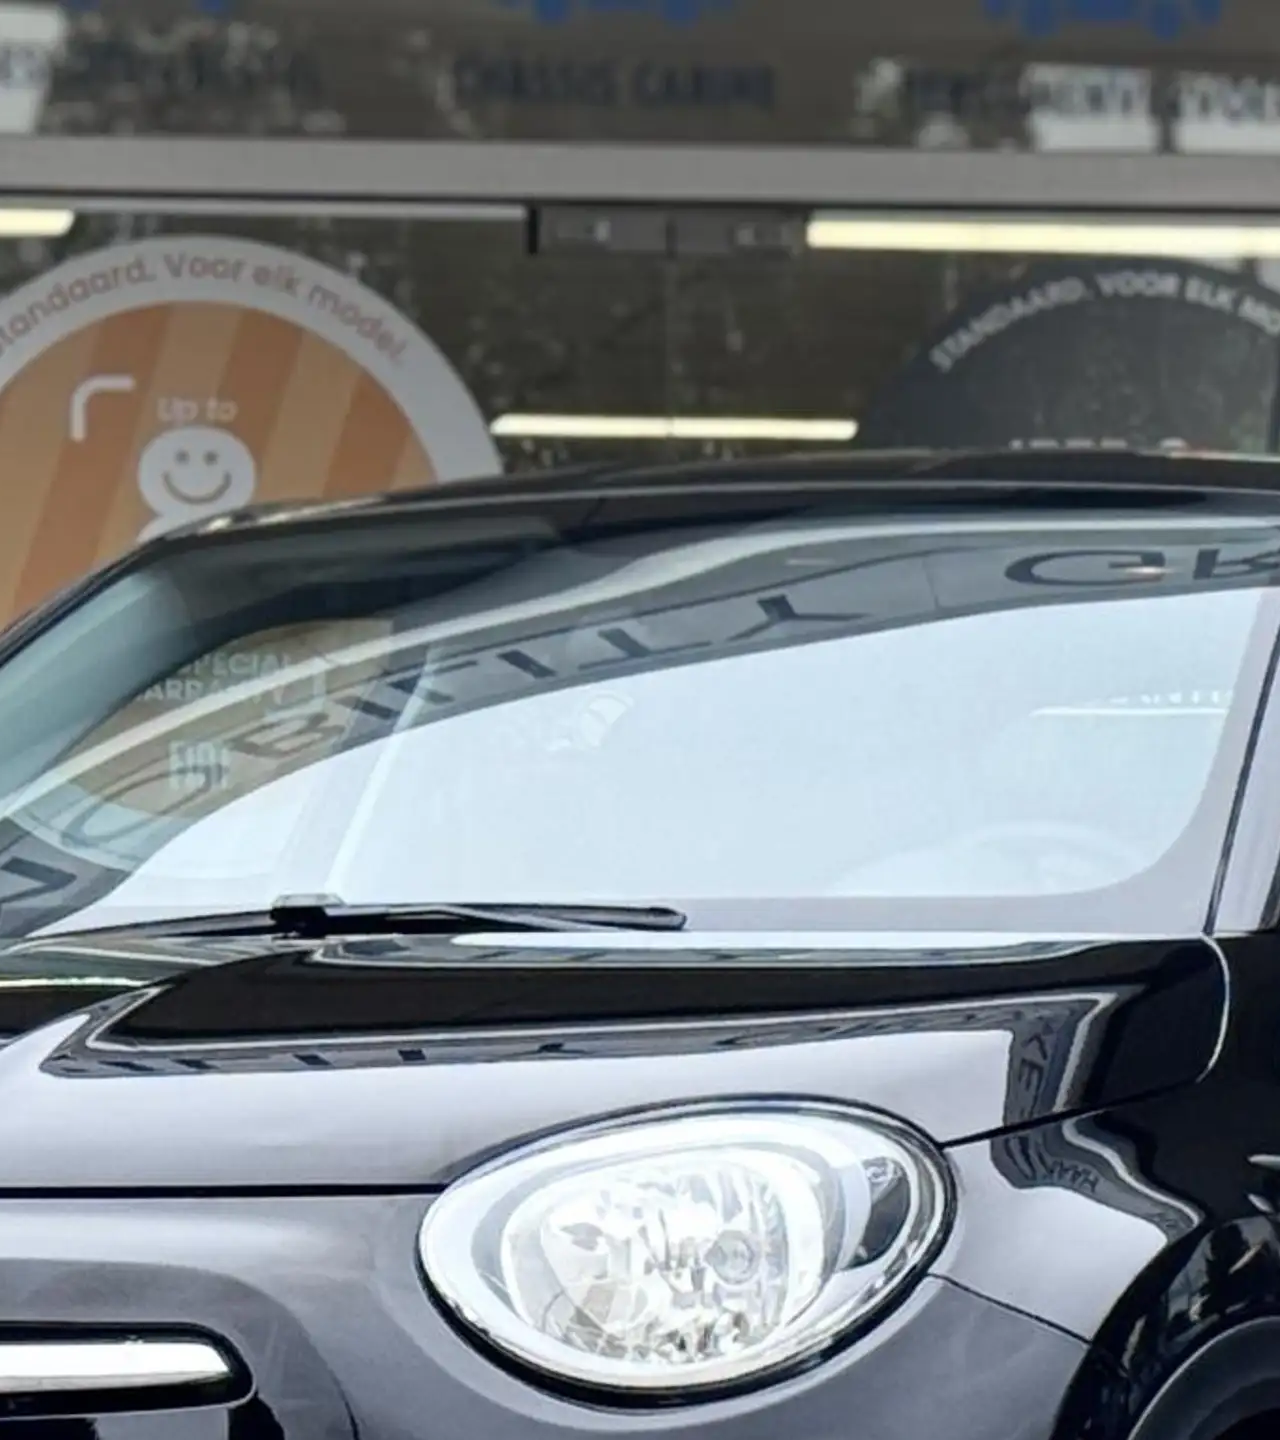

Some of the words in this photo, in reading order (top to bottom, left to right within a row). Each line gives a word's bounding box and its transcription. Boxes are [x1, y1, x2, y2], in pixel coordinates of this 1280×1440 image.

[162, 252, 246, 281] Voor
[252, 258, 302, 296] elk
[308, 285, 408, 368] model.
[1096, 271, 1181, 298] VOOR
[1185, 277, 1236, 313] ELK
[156, 396, 199, 424] Up
[206, 398, 239, 421] to
